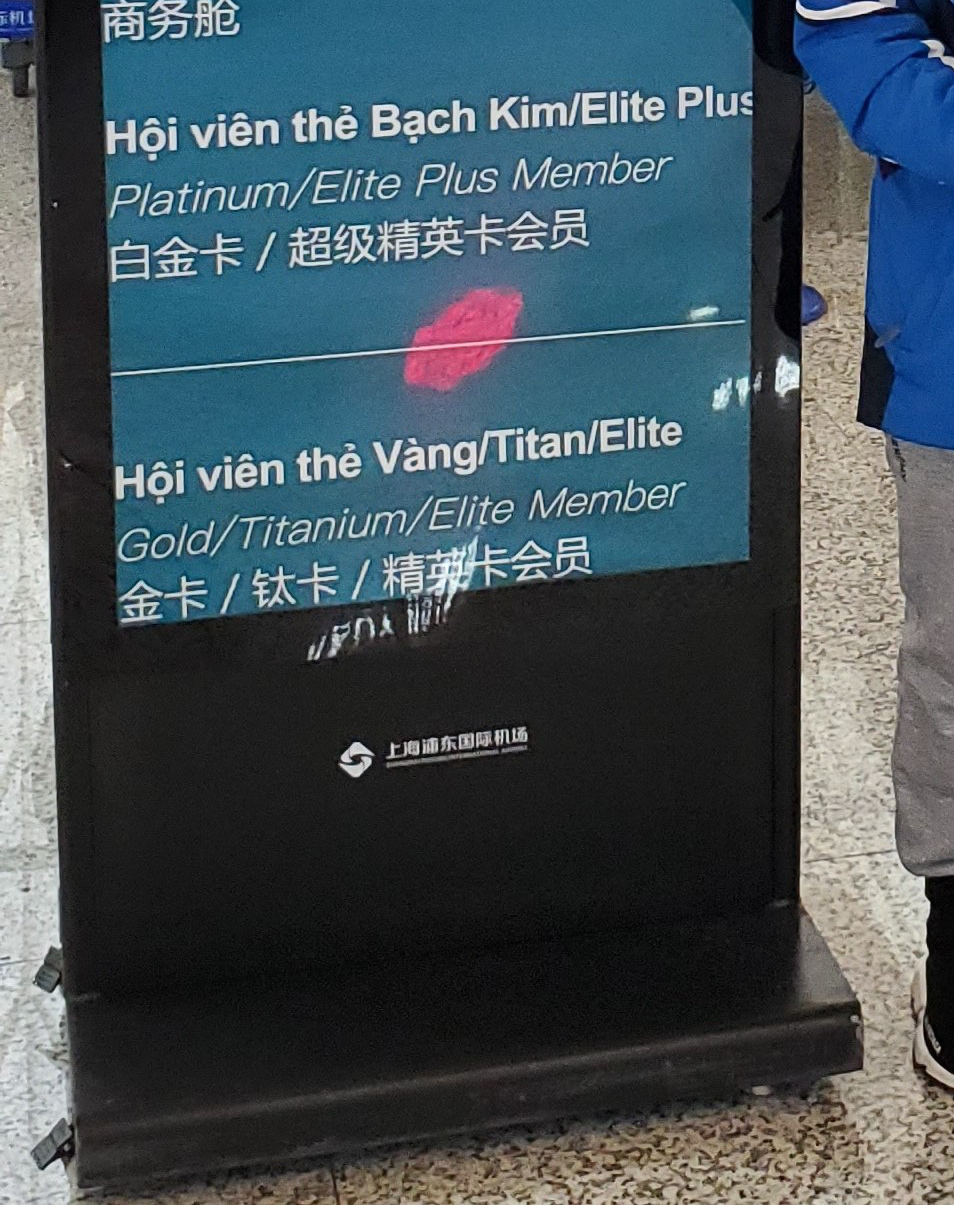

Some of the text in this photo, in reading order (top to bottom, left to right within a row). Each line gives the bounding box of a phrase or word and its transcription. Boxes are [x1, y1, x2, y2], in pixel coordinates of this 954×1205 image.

[106, 116, 178, 162] Hội
[191, 108, 280, 149] viên
[292, 103, 358, 141] thẻ
[371, 98, 477, 145] Bạch
[488, 90, 666, 133] Kim/Elite
[109, 152, 673, 219] Platinum/Elite Plus Member
[109, 232, 245, 283] 白金卡
[288, 208, 590, 269] 超级精英卡会员
[114, 415, 683, 506] Hội viên thẻ Vàng/Titan/Elite
[118, 478, 687, 564] Gold/Titanium/Elite Member
[119, 576, 209, 624] 金卡
[251, 559, 339, 608] 钛卡
[382, 535, 593, 598] 精英卡会员
[386, 726, 529, 760] 上海浦东国际机场
